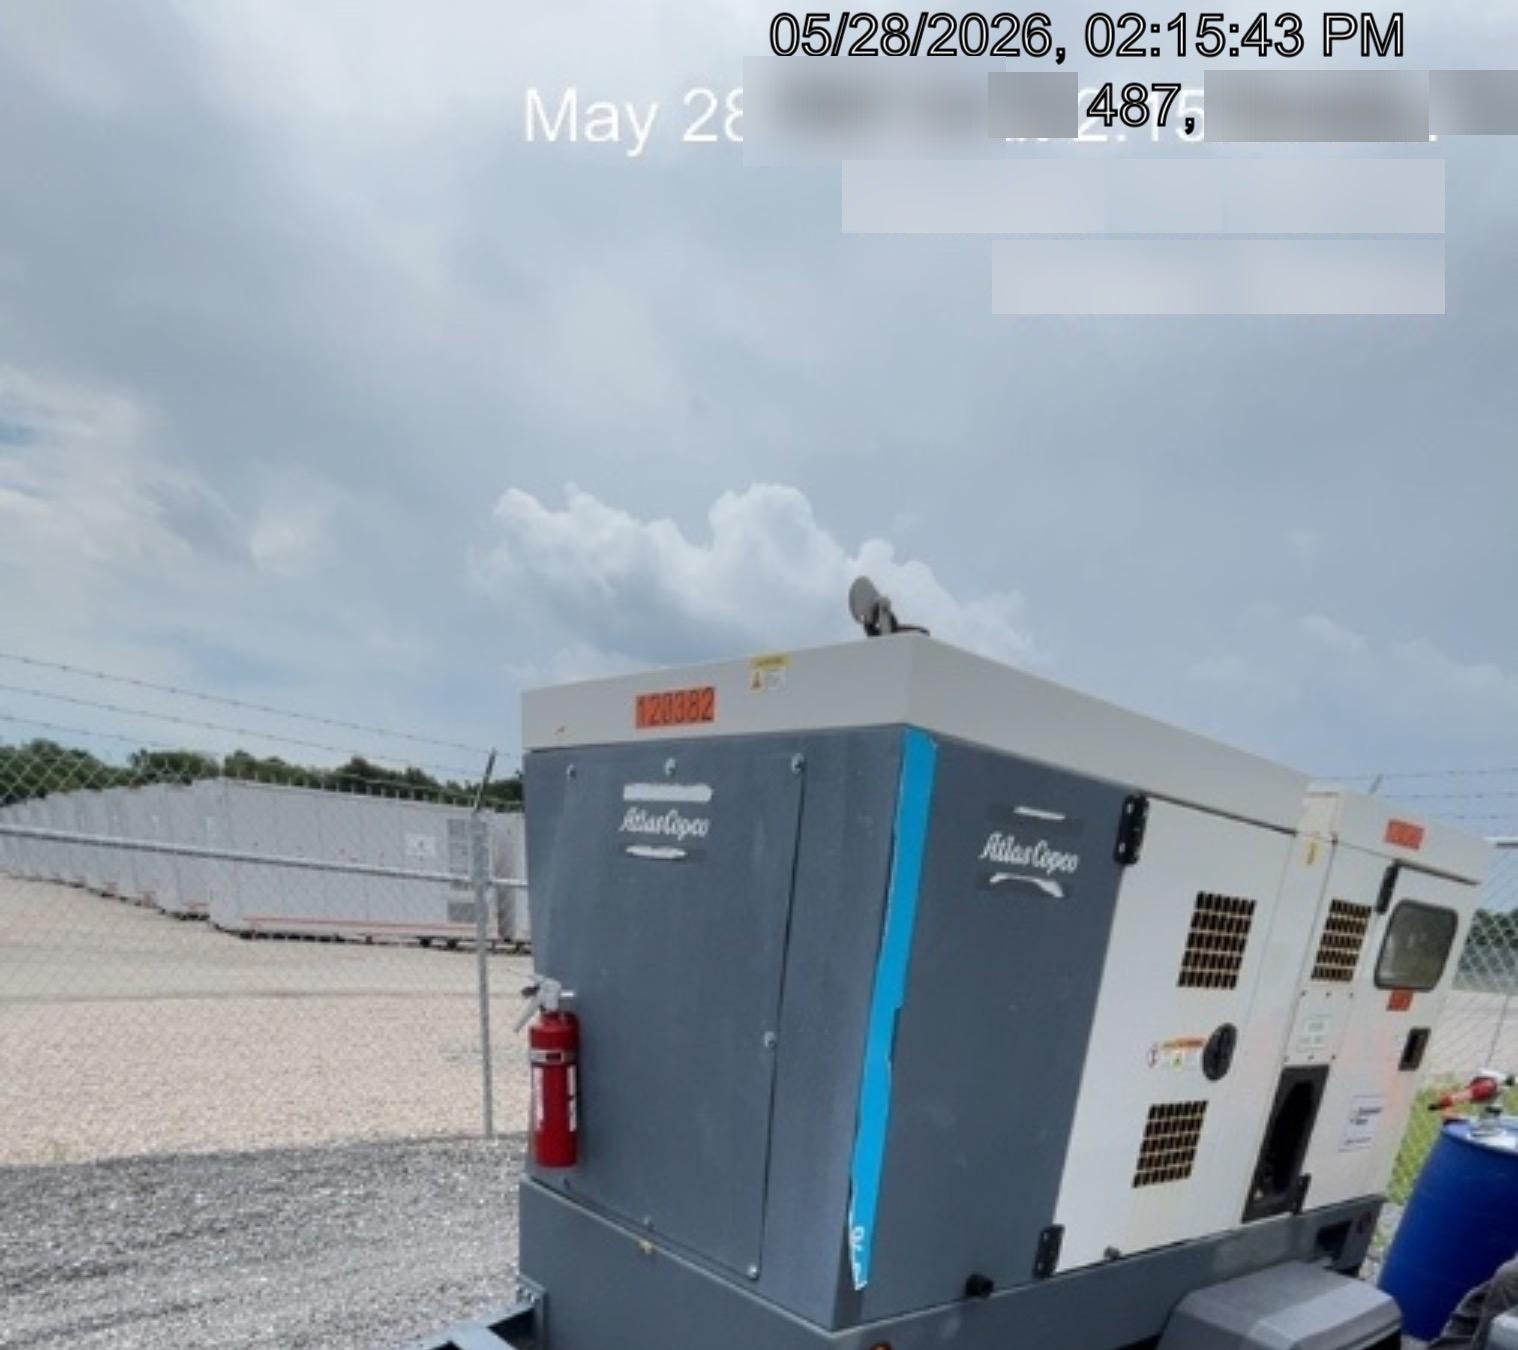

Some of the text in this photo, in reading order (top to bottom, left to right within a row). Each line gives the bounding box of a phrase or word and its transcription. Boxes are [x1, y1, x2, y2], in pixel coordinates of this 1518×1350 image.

[636, 686, 716, 729] 120382
[618, 806, 710, 841] Atlas Copco
[978, 831, 1079, 877] Atlas Copco
